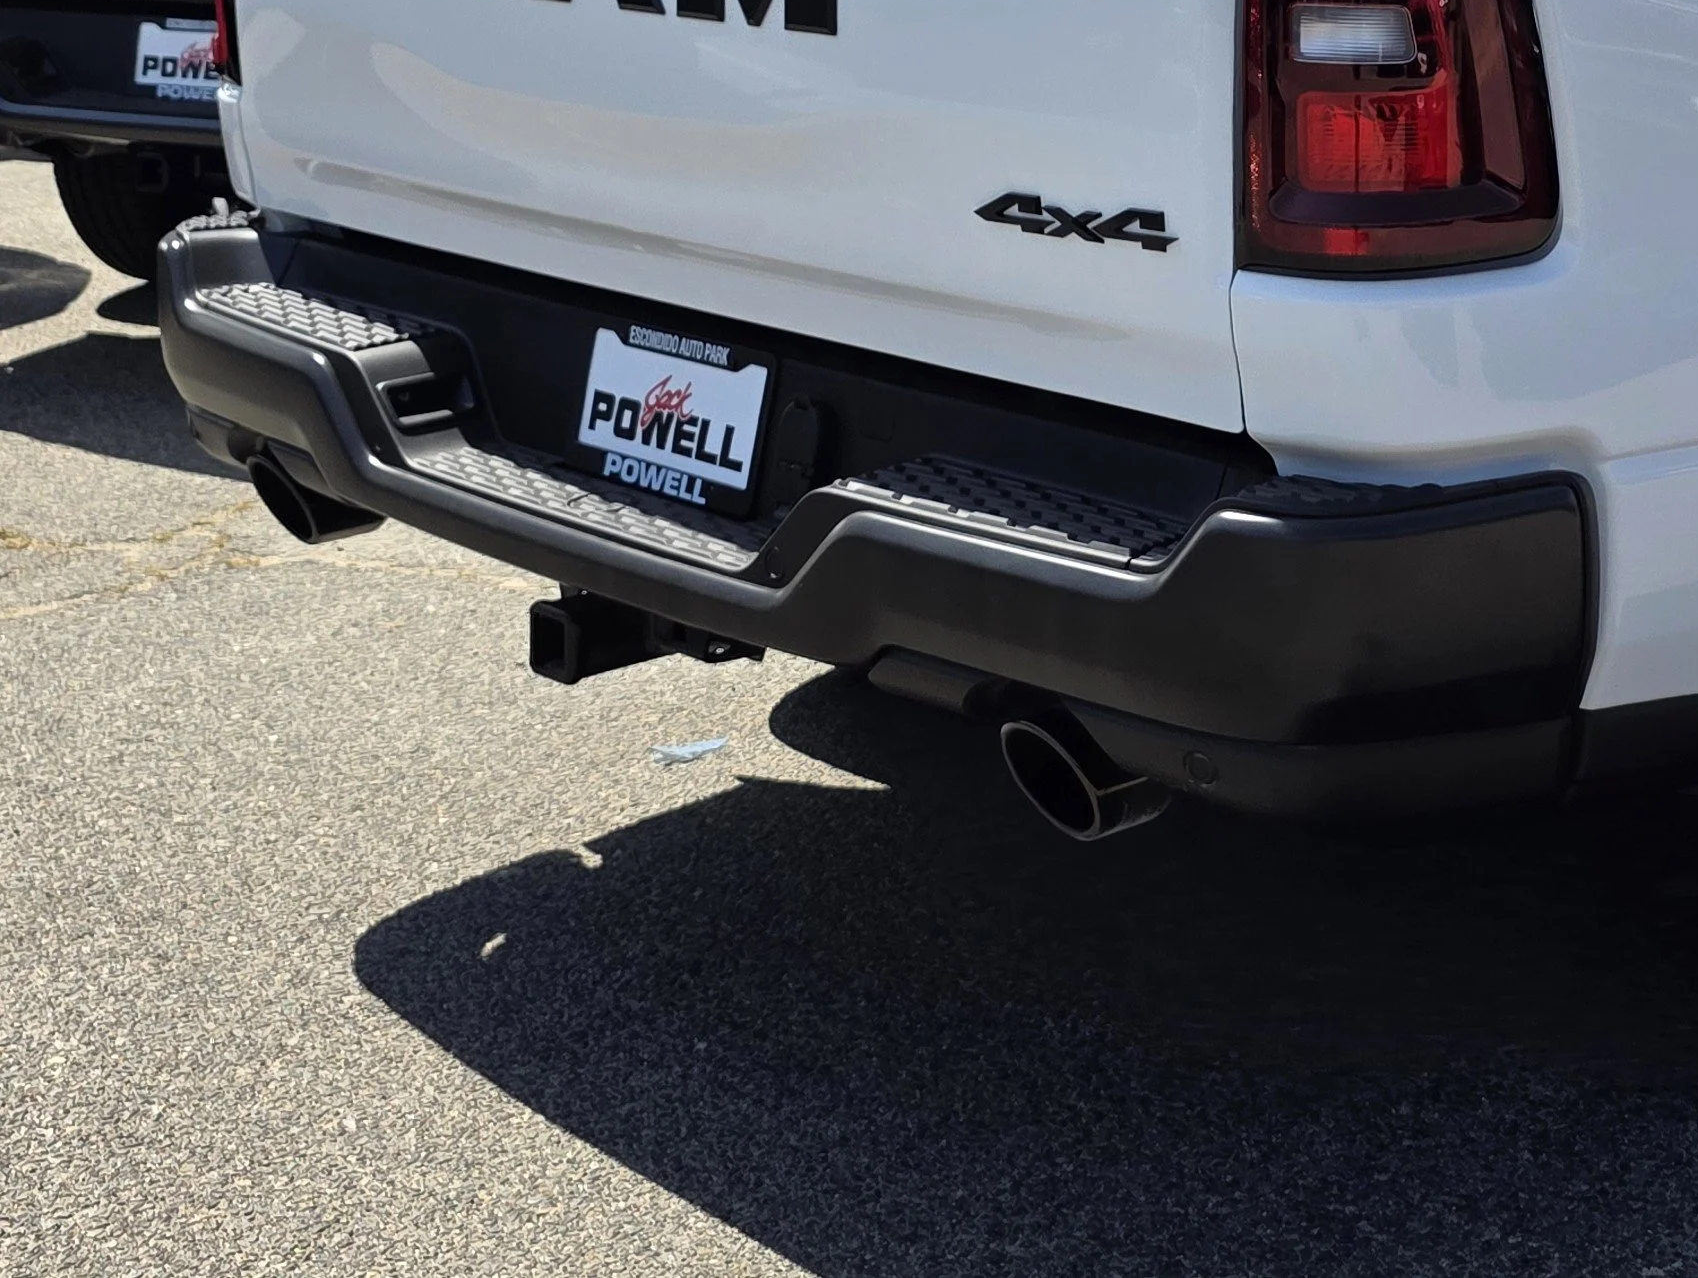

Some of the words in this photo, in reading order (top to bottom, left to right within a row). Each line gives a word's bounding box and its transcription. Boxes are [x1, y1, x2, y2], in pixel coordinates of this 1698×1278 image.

[141, 54, 219, 80] POWE
[157, 84, 217, 100] POWE
[629, 325, 680, 354] ESCONDIDO
[680, 337, 704, 360] AUTO
[703, 343, 731, 366] PARK
[640, 374, 694, 427] Jack
[588, 388, 744, 473] POWELL
[603, 452, 706, 506] POWELL
